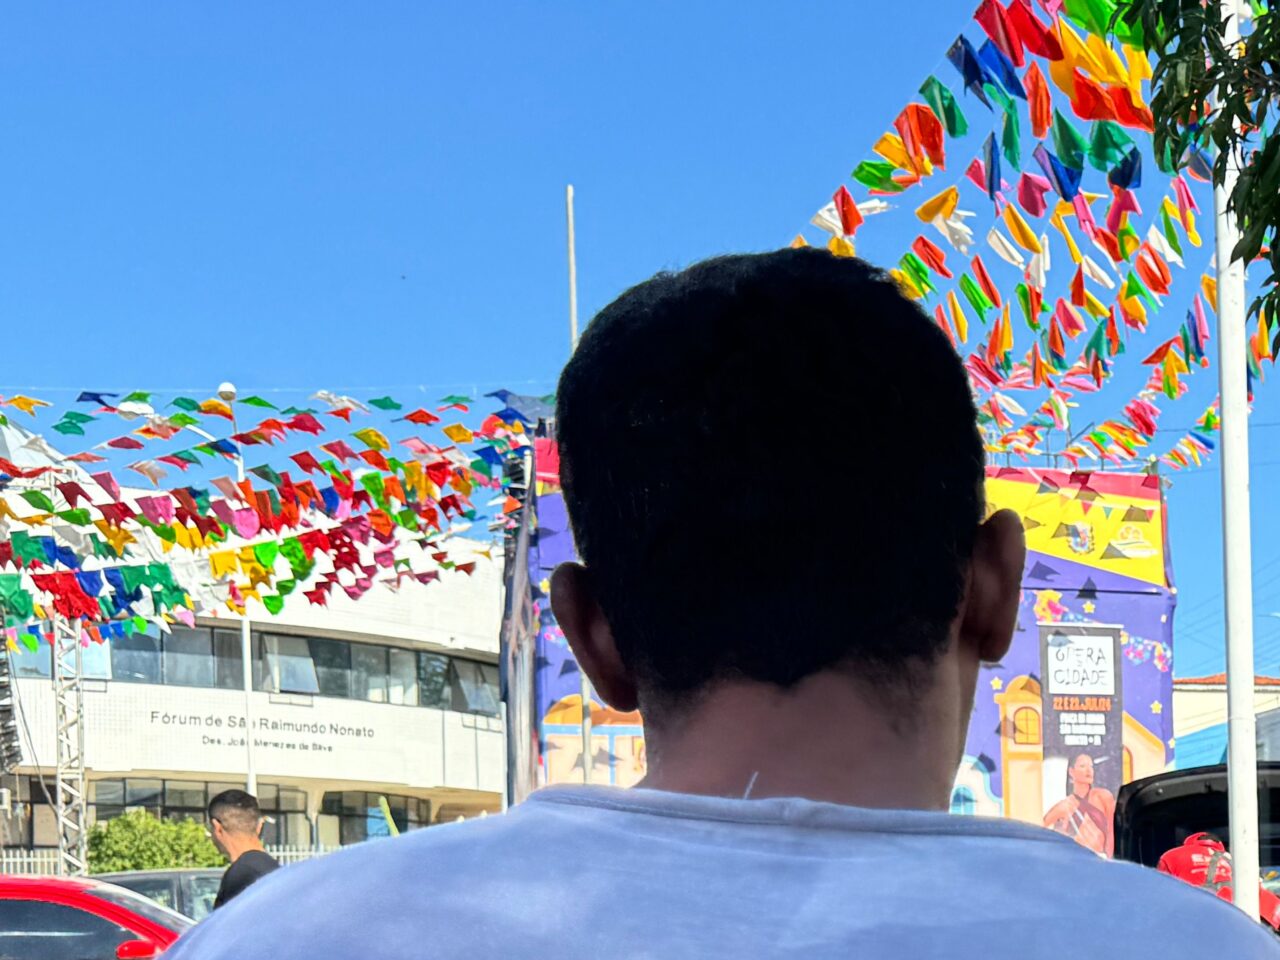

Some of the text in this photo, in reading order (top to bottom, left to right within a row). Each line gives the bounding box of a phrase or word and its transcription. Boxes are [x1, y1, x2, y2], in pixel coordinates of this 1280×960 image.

[1054, 668, 1108, 686] CIDADE
[150, 711, 201, 726] Fórum
[205, 715, 222, 727] de
[259, 718, 326, 734] Raimundo
[329, 723, 375, 737] Nonato
